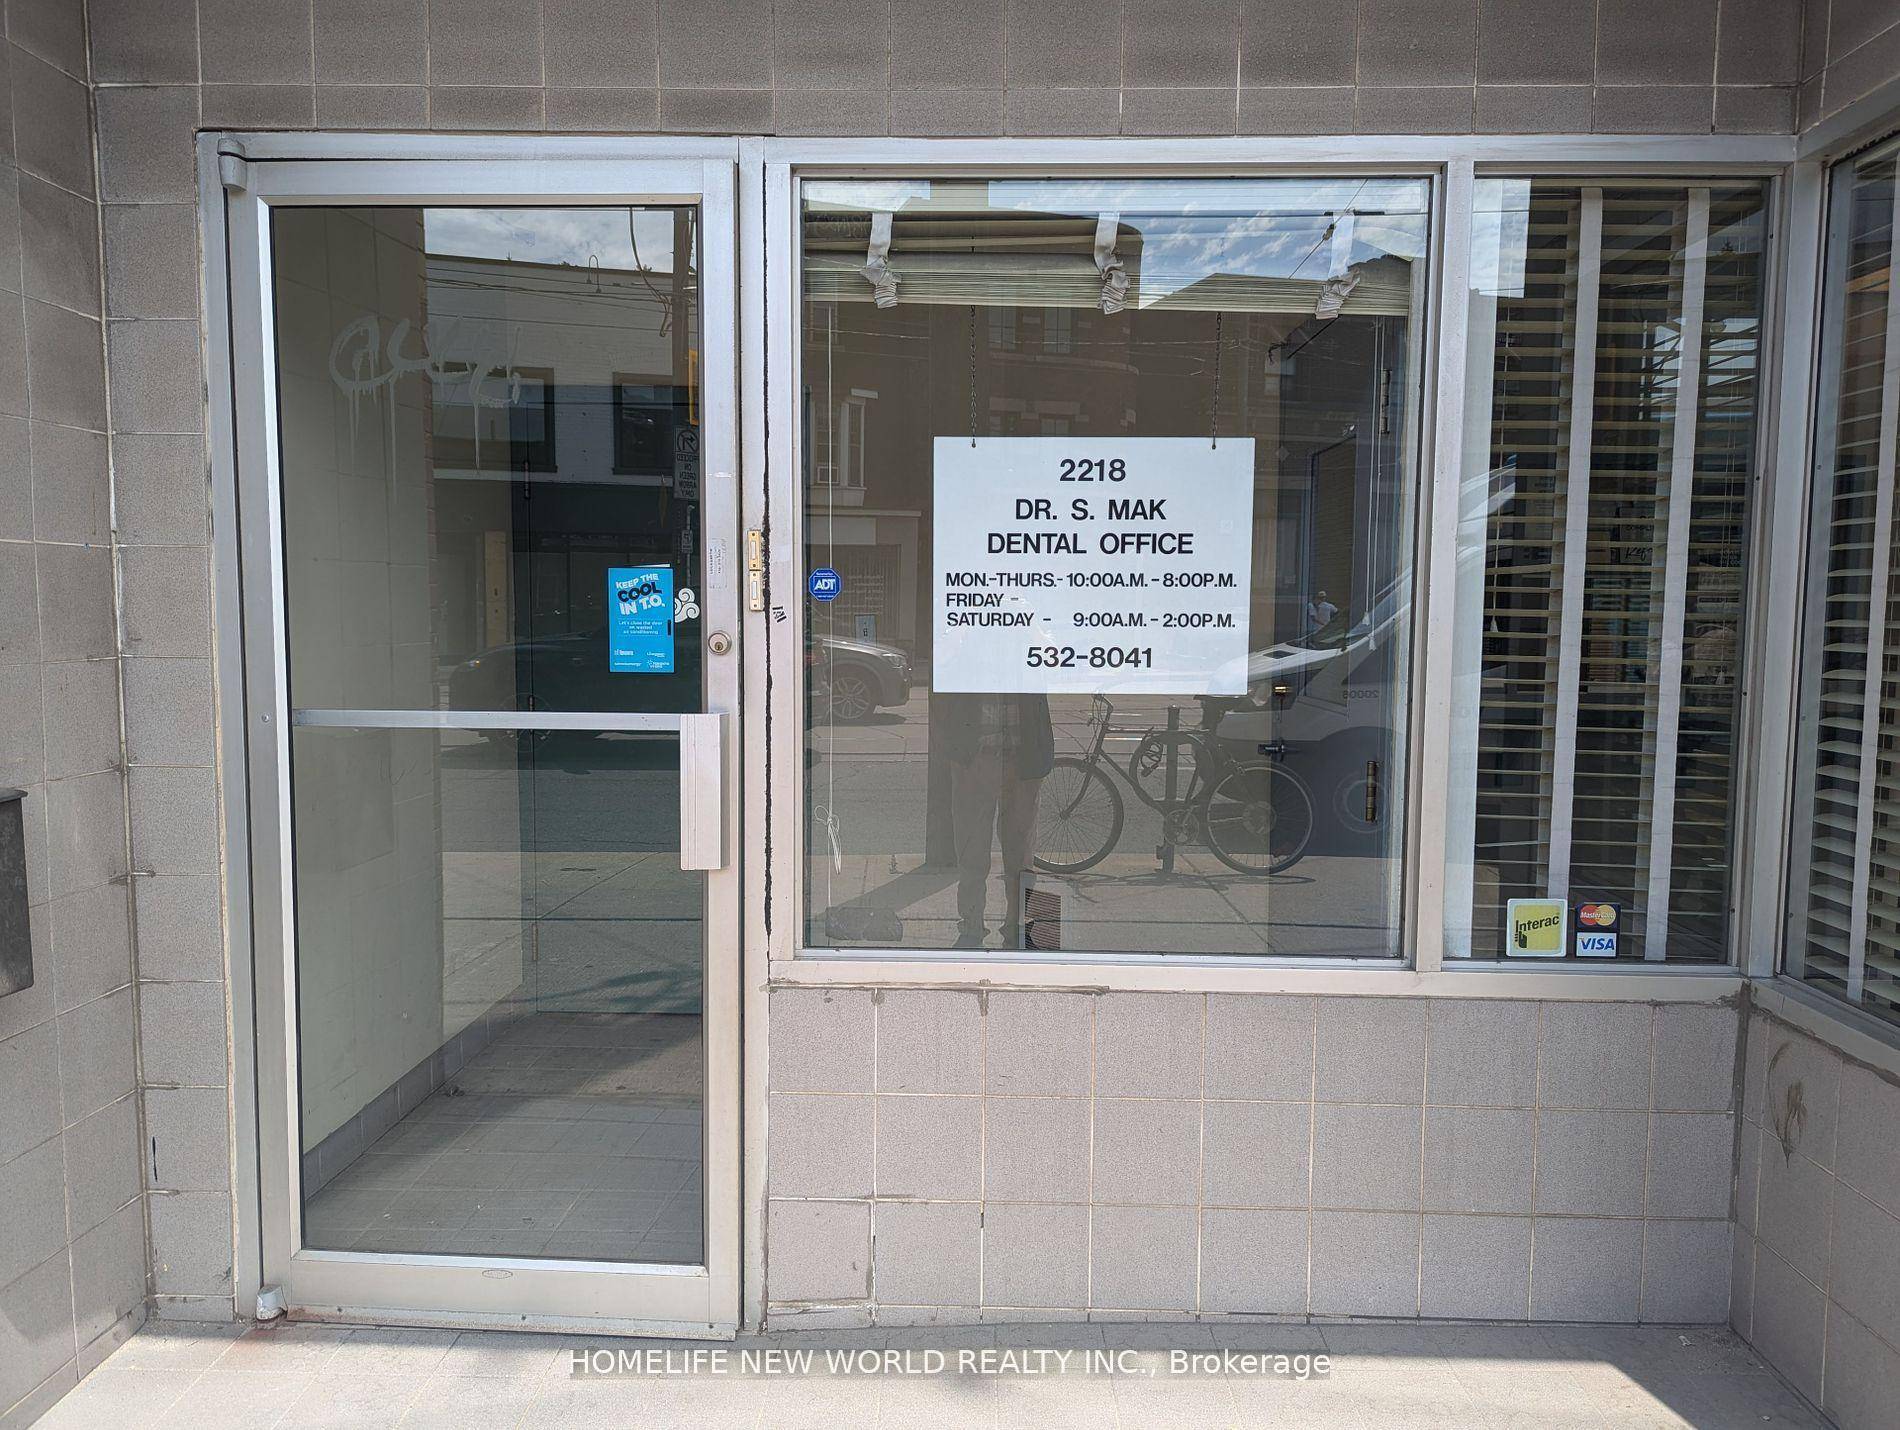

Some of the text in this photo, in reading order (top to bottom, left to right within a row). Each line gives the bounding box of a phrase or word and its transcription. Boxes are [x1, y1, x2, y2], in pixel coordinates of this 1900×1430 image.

[1060, 459, 1127, 483] 2218
[1015, 498, 1167, 521] DR. S. MAK
[987, 533, 1194, 555] DENTAL OFFICE
[615, 573, 659, 589] KEEP THE
[814, 578, 836, 591] ADT
[617, 581, 663, 603] COOL
[946, 593, 1004, 608] FRIDAY
[619, 594, 666, 616] IN T.O.
[946, 612, 1035, 627] SATURDAY
[1026, 646, 1152, 668] 532-8041
[1515, 916, 1560, 934] Interac
[1581, 937, 1615, 951] VISA
